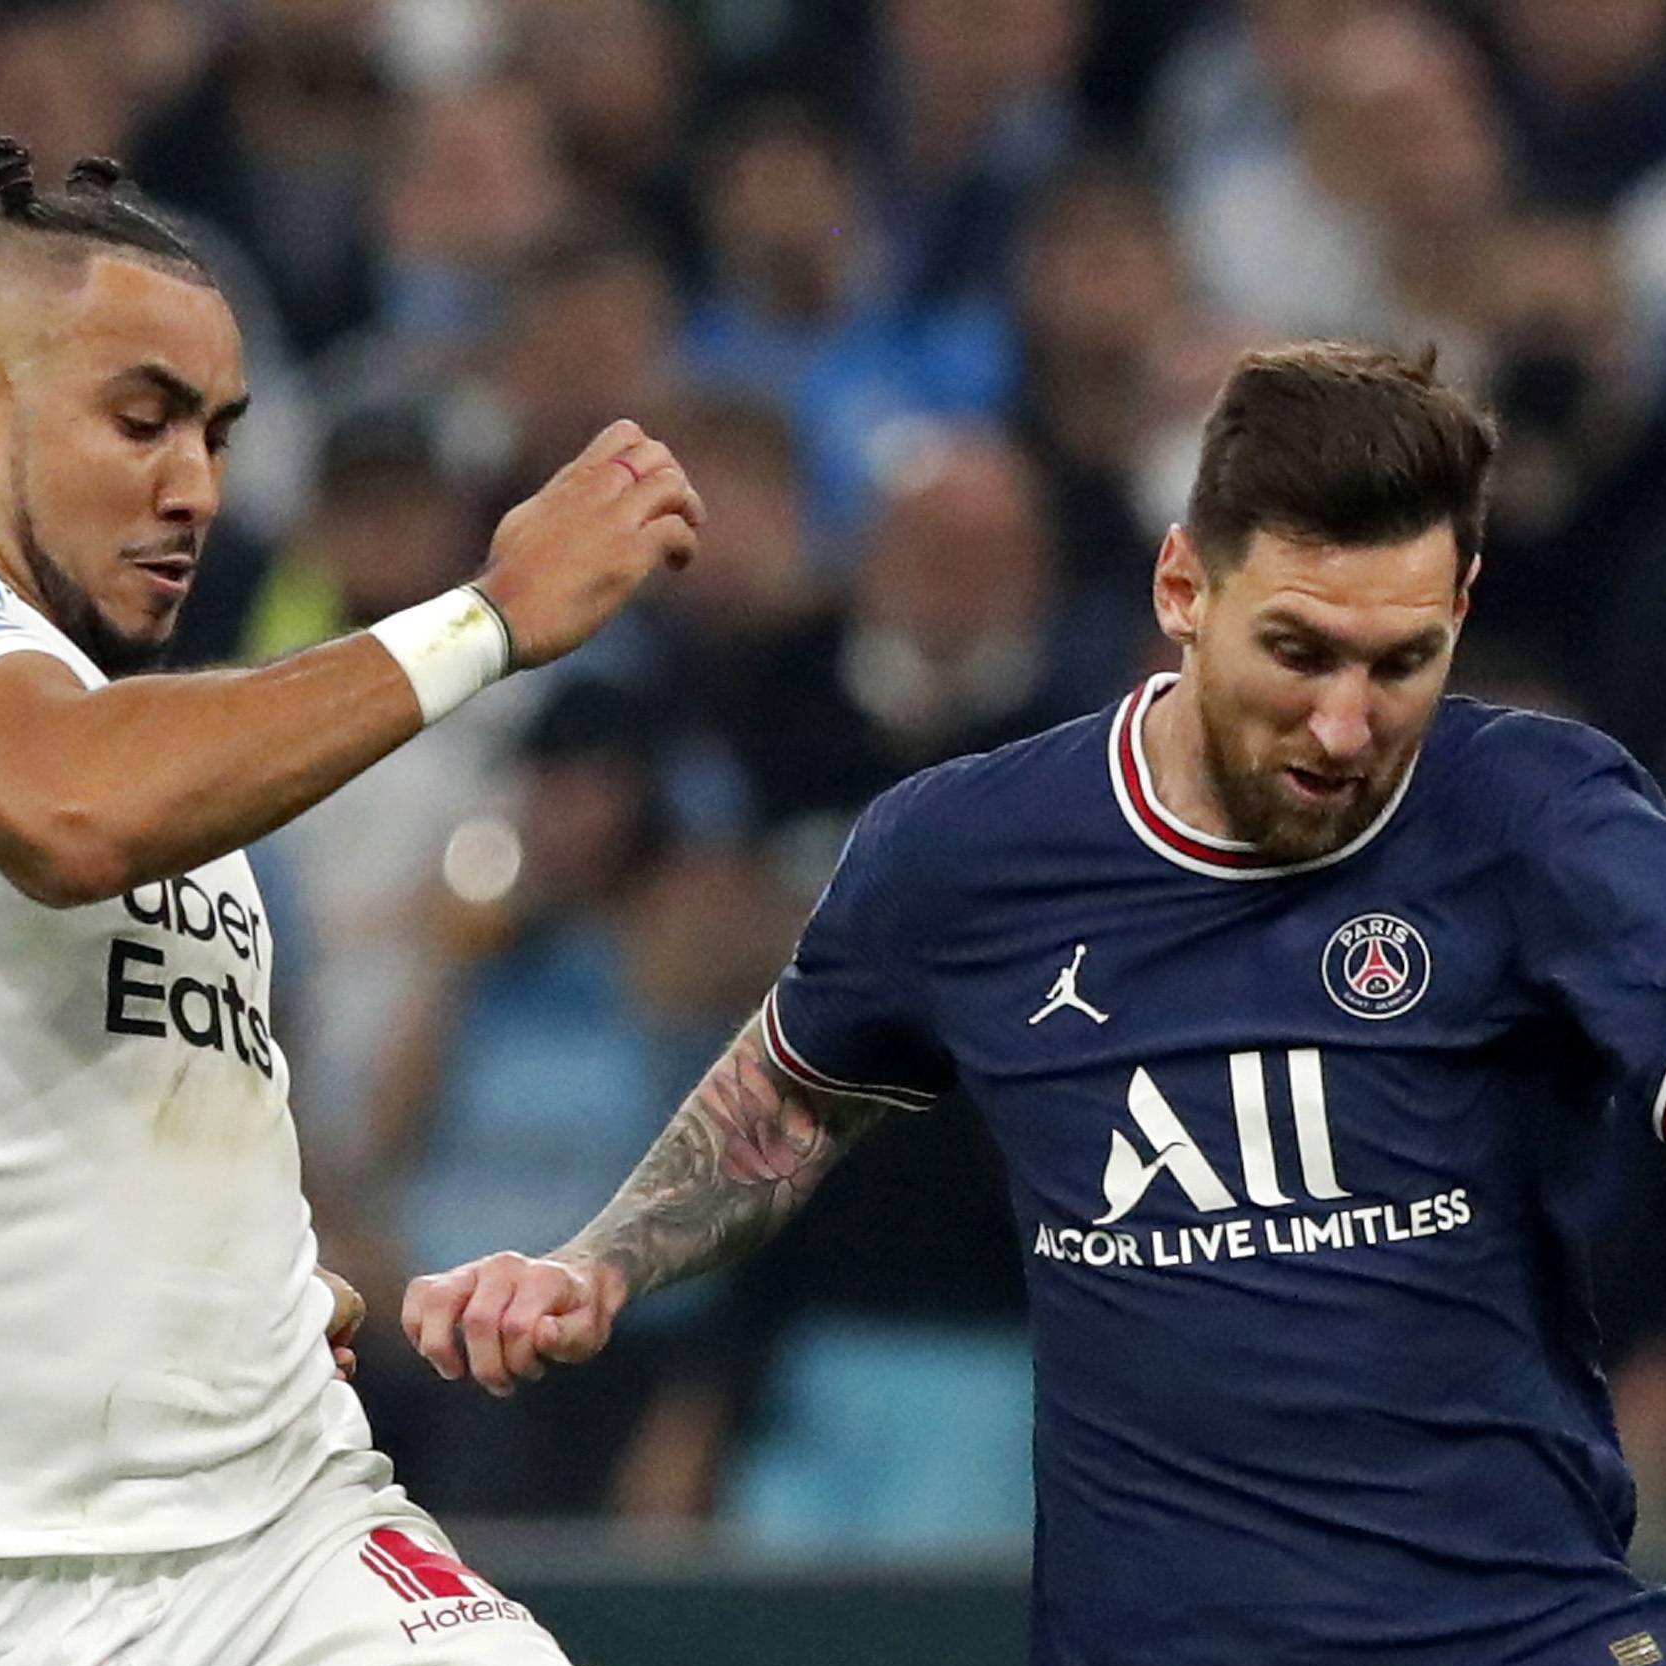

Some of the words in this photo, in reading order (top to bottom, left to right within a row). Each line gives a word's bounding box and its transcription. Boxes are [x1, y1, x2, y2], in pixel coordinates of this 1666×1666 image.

[1339, 919, 1409, 947] PARIS
[106, 937, 272, 1080] Eats
[1153, 1220, 1255, 1267] LIVE
[1266, 1188, 1471, 1254] LIMITLESS
